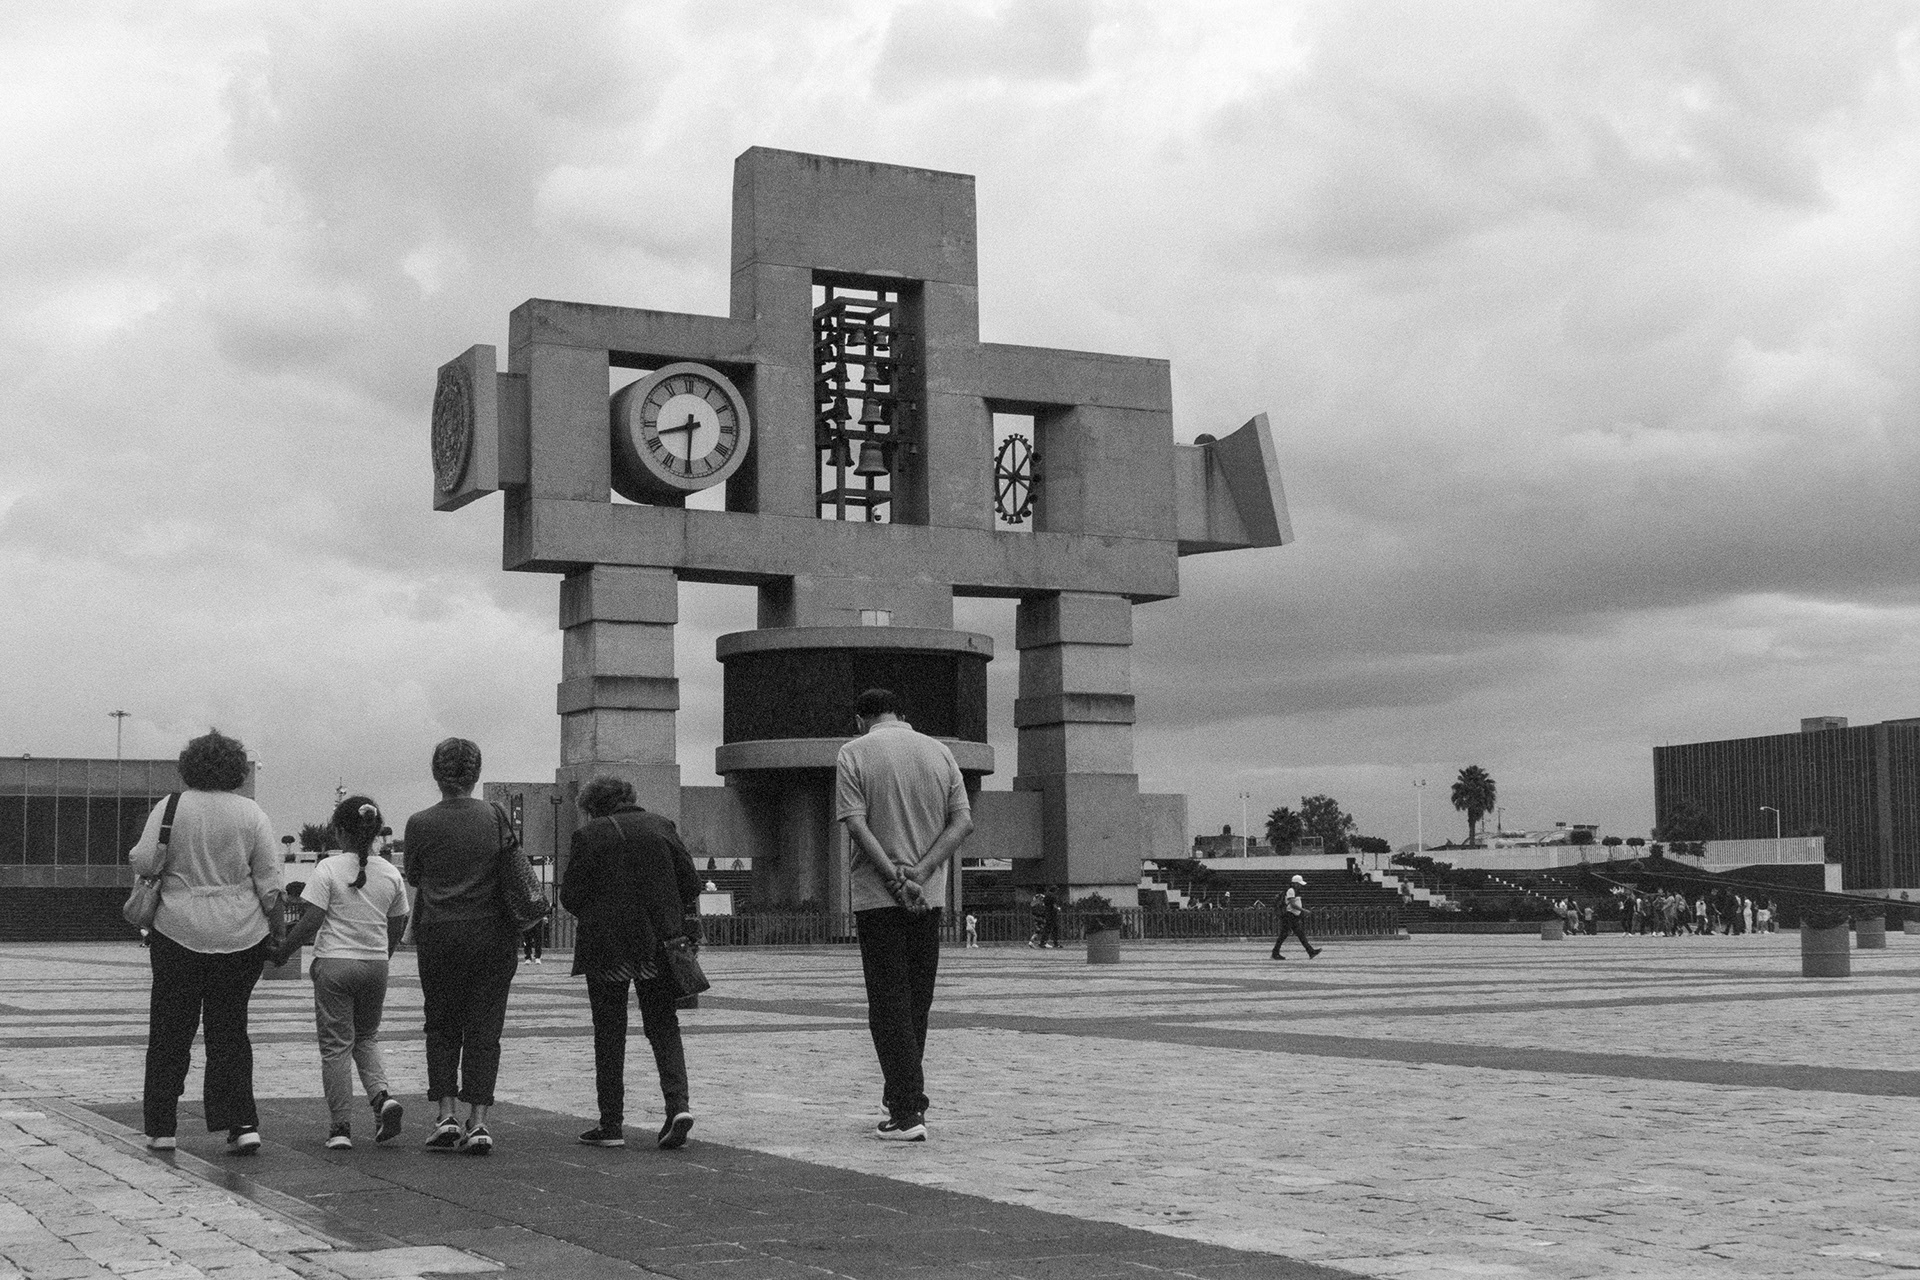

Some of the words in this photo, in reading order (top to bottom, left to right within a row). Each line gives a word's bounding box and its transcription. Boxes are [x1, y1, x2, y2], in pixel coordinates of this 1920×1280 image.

[704, 386, 712, 399] I
[715, 404, 728, 414] II
[720, 425, 733, 435] III
